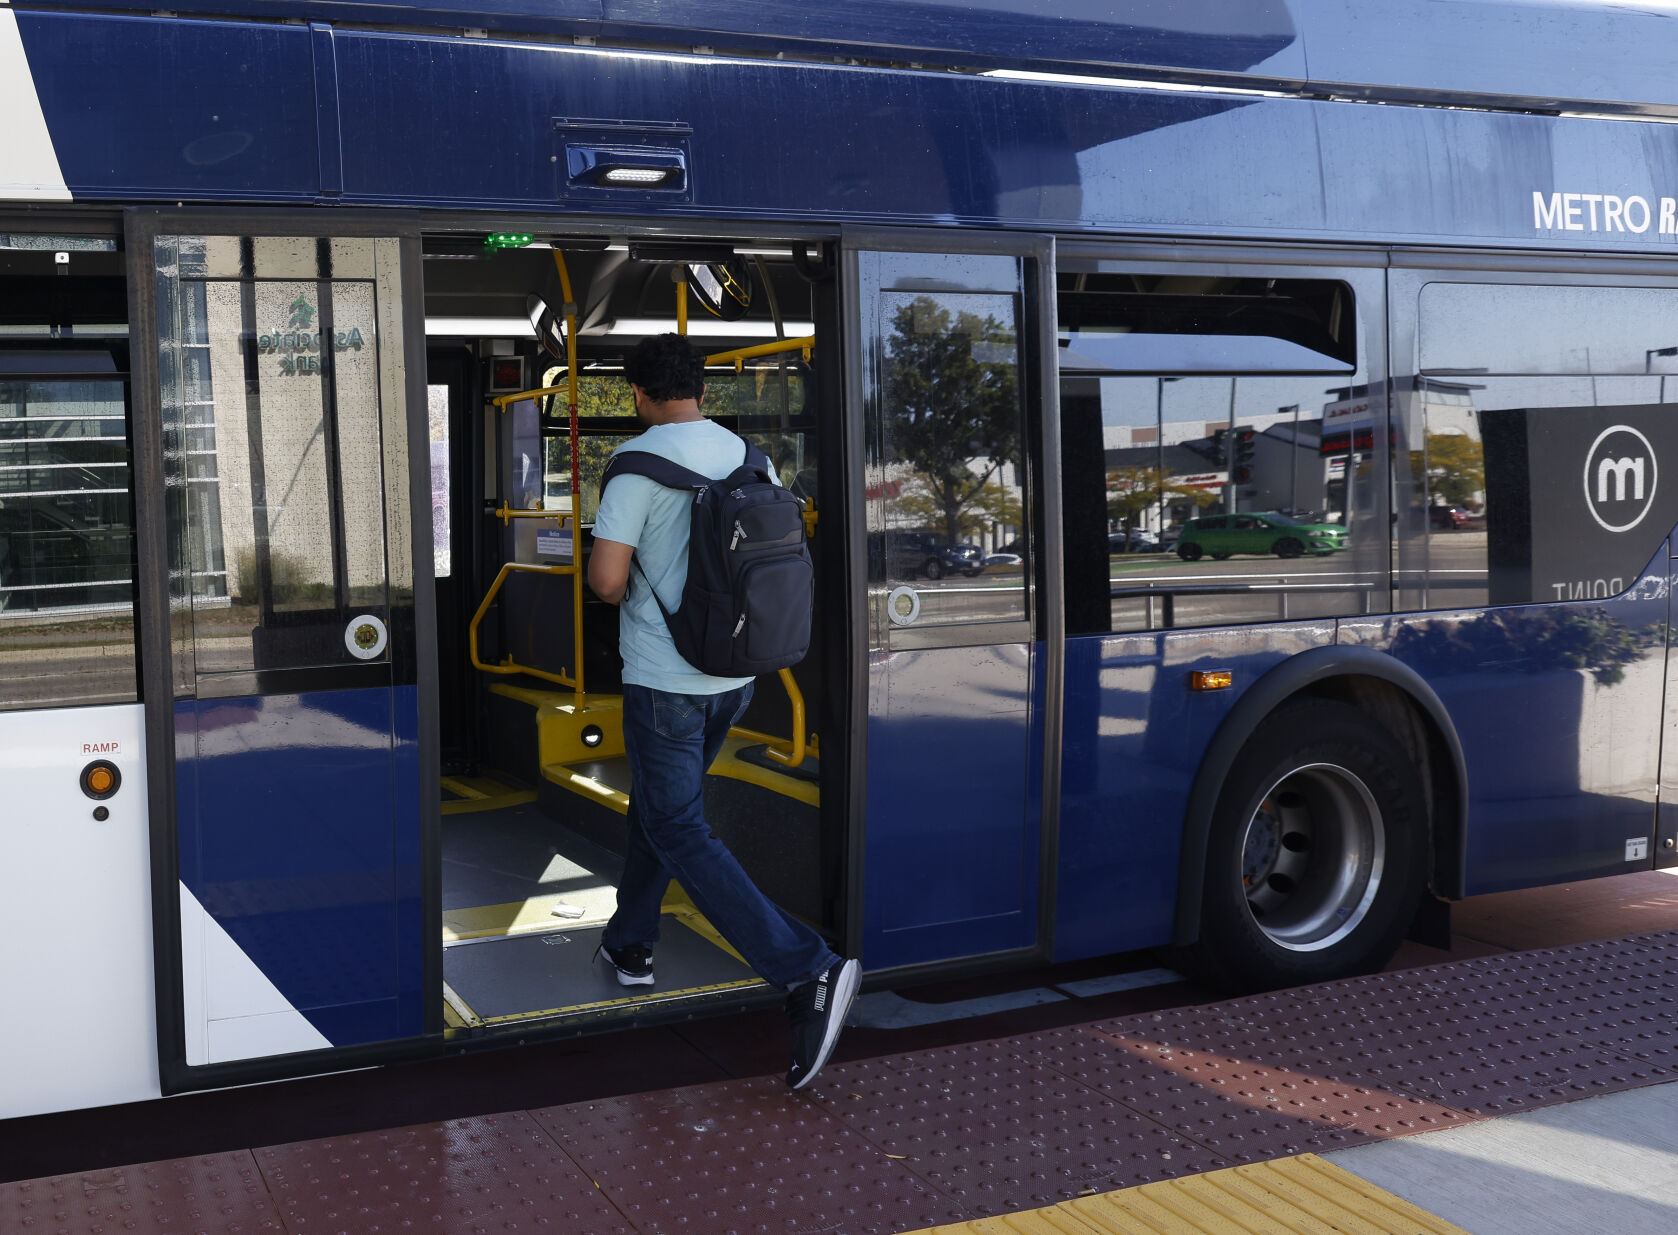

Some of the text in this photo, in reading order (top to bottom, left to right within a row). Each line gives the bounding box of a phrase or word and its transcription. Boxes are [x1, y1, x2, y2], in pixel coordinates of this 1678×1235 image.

[1533, 191, 1678, 234] METRO R
[83, 742, 119, 753] RAMP
